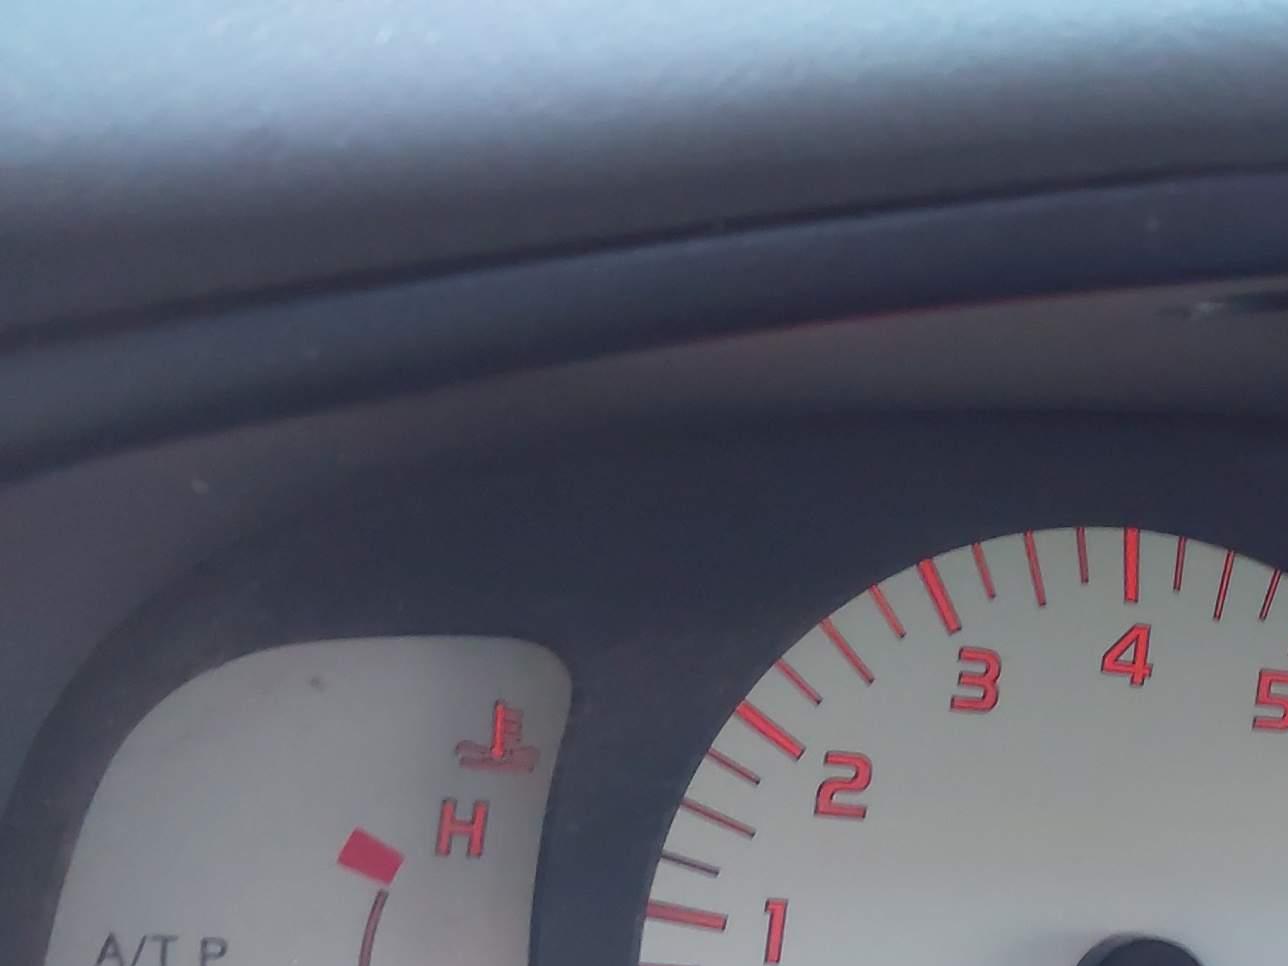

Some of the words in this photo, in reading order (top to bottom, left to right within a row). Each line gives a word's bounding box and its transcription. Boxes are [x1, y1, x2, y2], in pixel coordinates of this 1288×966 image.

[949, 645, 1001, 712] 3
[1100, 622, 1153, 687] 4
[813, 750, 873, 819] 2
[434, 798, 488, 858] H
[763, 896, 789, 966] 1
